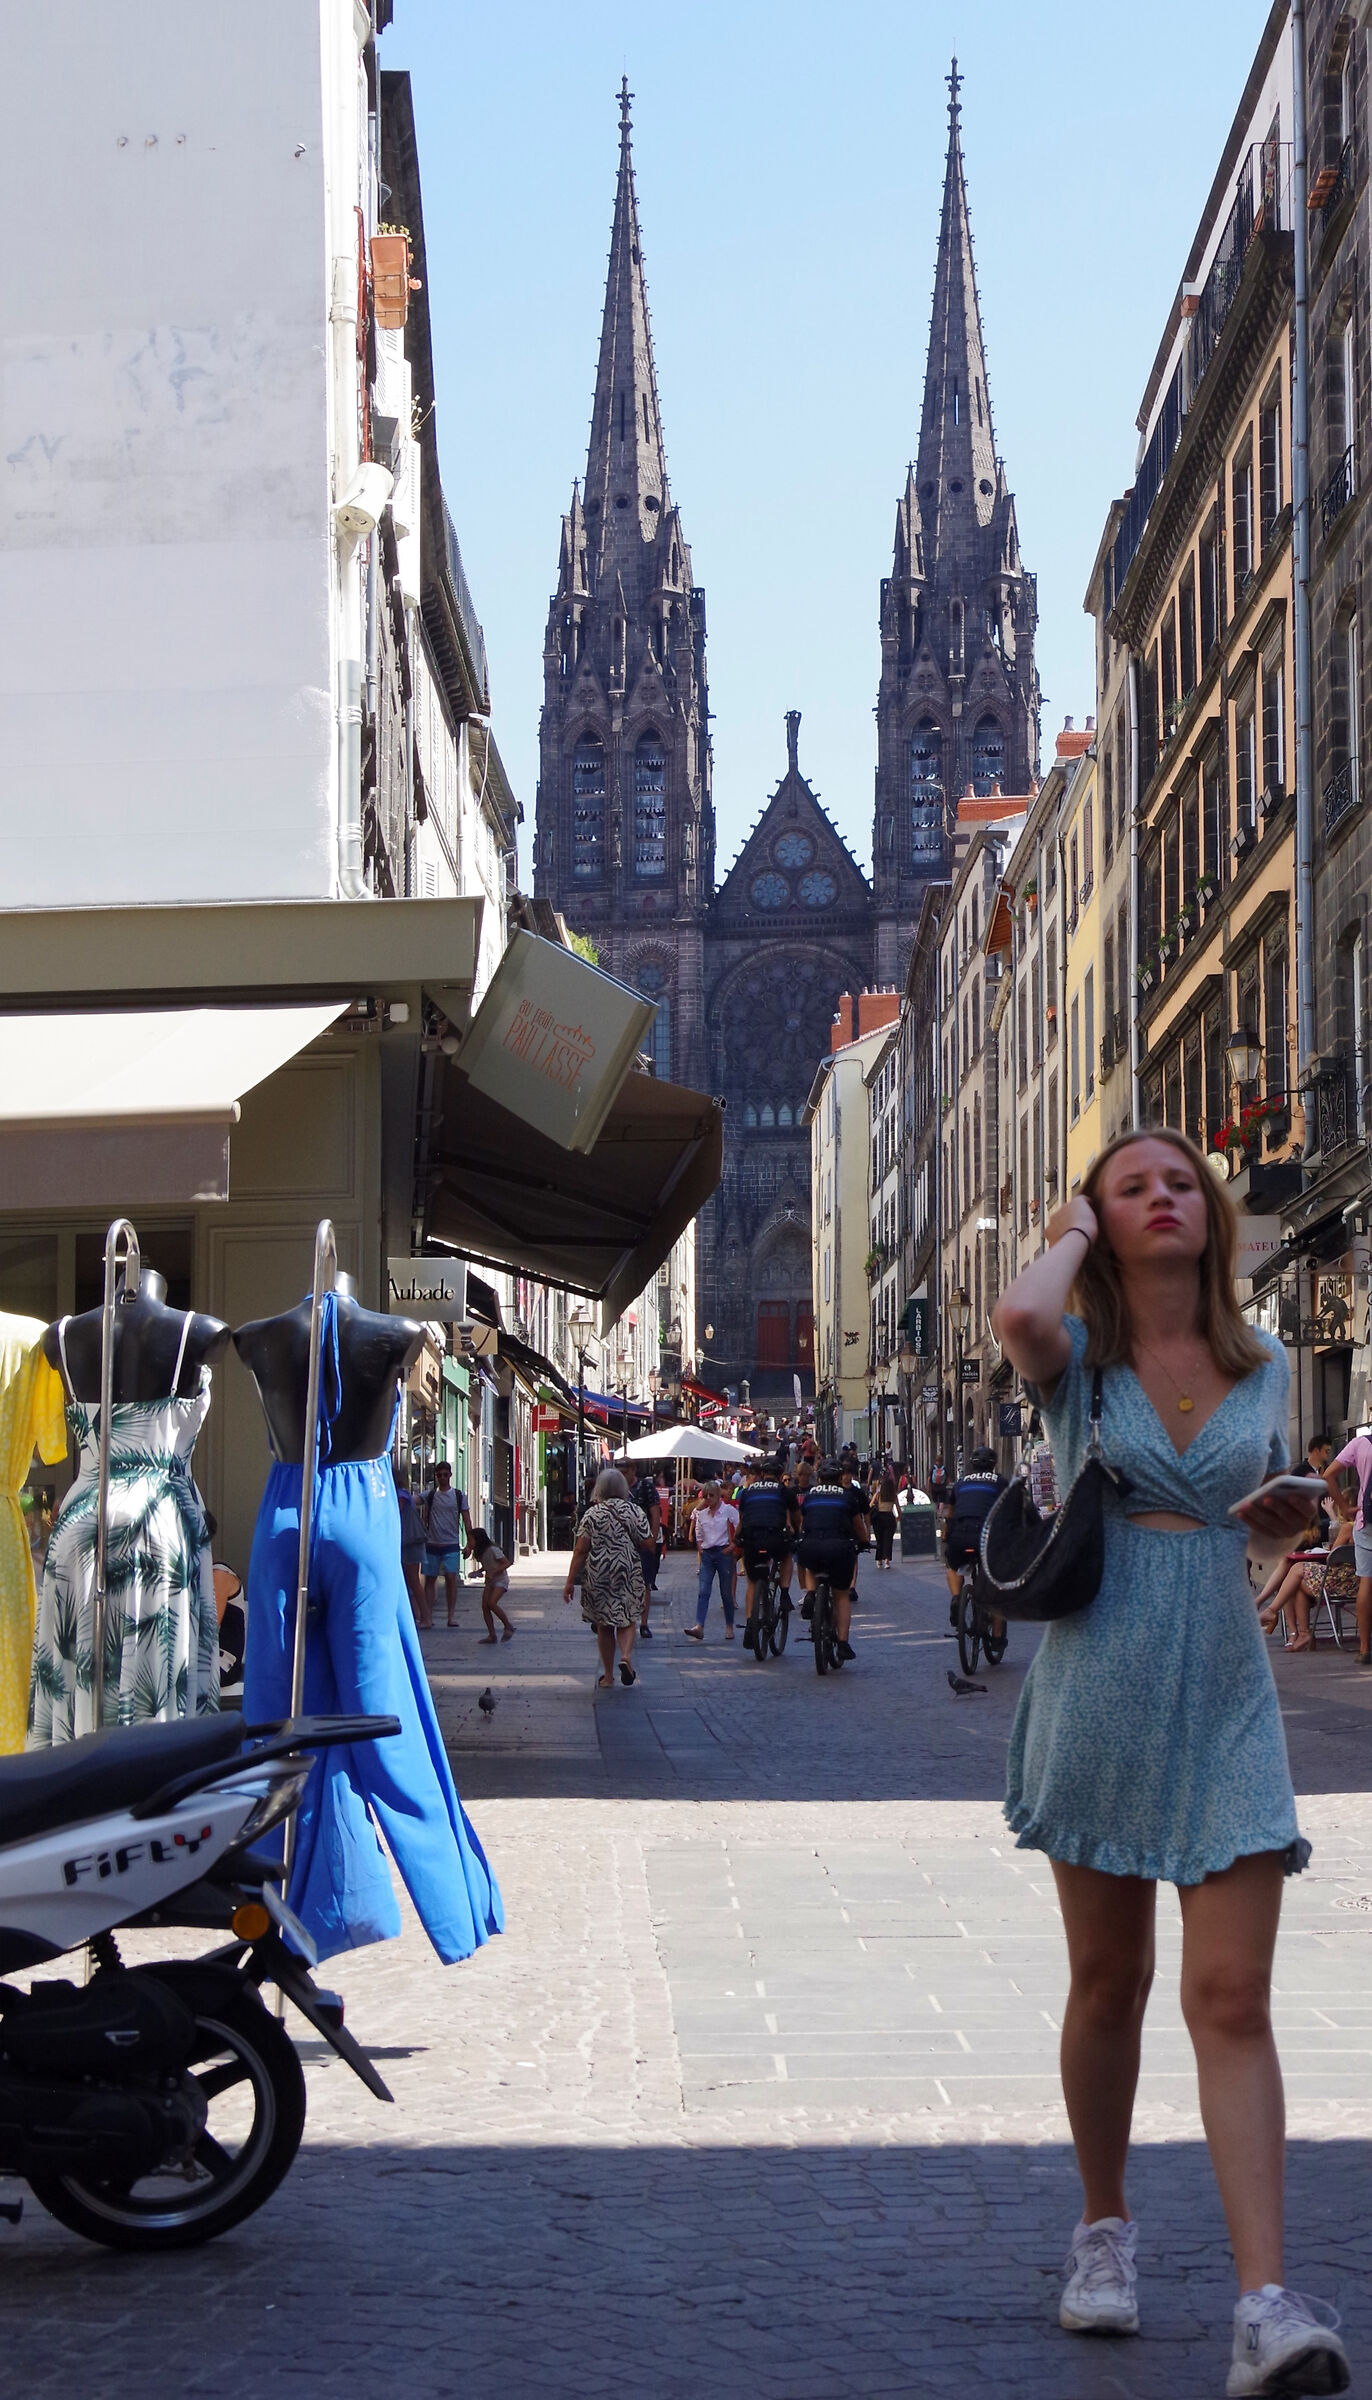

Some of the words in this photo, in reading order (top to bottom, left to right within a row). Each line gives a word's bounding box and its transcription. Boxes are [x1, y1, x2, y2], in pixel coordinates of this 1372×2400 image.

[519, 999, 534, 1017] au
[531, 1008, 555, 1031] pain
[502, 1014, 591, 1095] PAILLASSE
[389, 1277, 454, 1300] Aubade
[748, 1481, 779, 1490] POLICE
[963, 1472, 998, 1482] POLICE
[809, 1485, 844, 1494] POLICE
[1247, 2323, 1261, 2350] N
